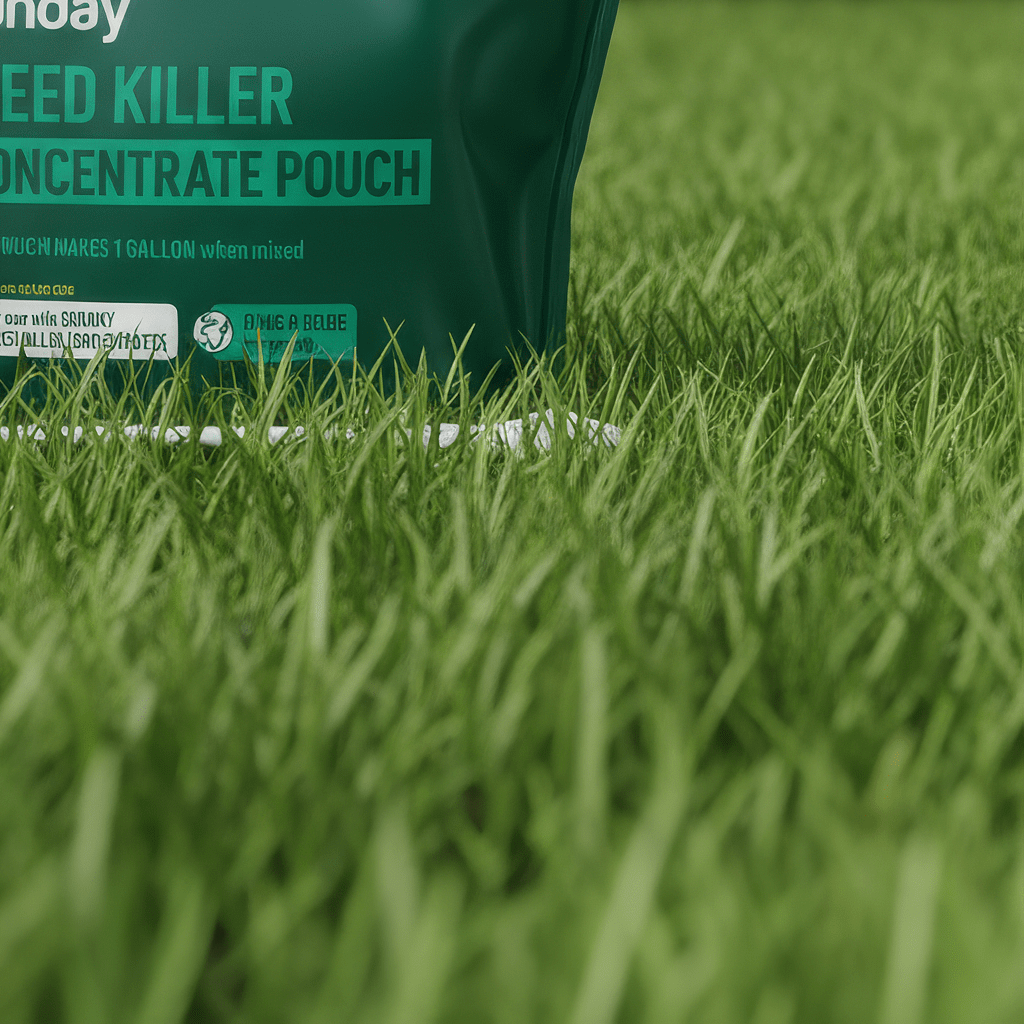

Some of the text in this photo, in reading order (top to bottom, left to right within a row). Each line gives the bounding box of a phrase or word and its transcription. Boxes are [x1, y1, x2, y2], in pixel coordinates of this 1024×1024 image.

[114, 65, 294, 125] KILLER
[276, 149, 420, 198] POUCH
[126, 239, 196, 259] GALLON
